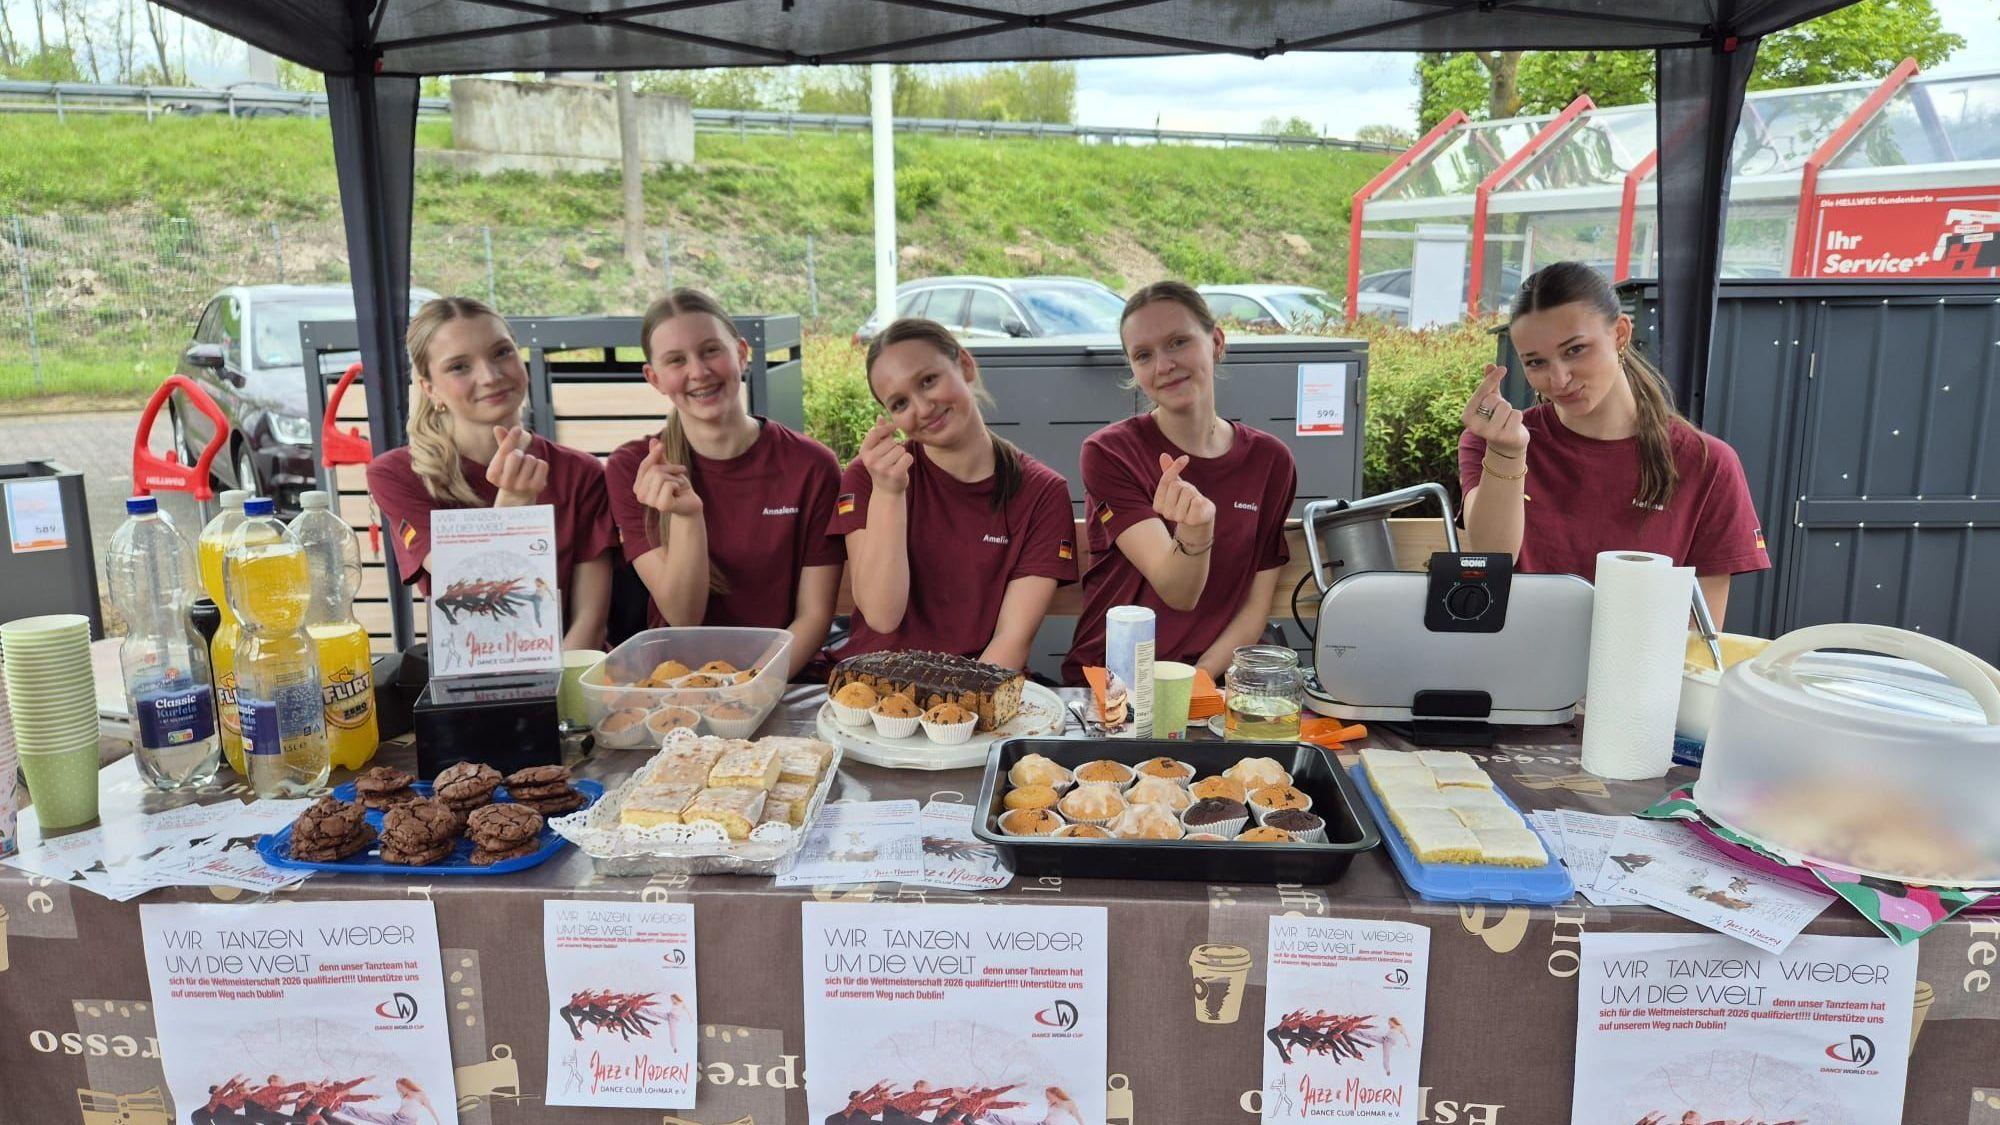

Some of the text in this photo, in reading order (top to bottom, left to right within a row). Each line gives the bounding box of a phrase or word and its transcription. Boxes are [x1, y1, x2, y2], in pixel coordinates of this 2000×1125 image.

[1820, 196, 1934, 208] Die HELLWEG Kundenkarte
[1827, 230, 1862, 250] Ihr
[1822, 252, 1930, 274] Service+
[1234, 501, 1258, 512] Leonie
[982, 534, 1008, 544] Amelie
[322, 672, 371, 704] FLIRT
[155, 694, 196, 708] Classic
[164, 954, 418, 974] UM DIE WELT denn unser Tanzteam hat
[825, 954, 1084, 976] UM DIE WELT denn unser Tanzteam hat
[169, 974, 419, 988] sich für die Weltmeisterschaft 2026 qualifiziert!!!! Unterstütze uns
[825, 976, 1083, 990] sich für die Weltmeisterschaft 2026 qualifiziert!!!! Unterstütze uns
[171, 990, 284, 1000] auf unserem Weg nach Dublin!
[826, 990, 944, 1000] auf unserem Weg nach Dublin!
[1601, 984, 1886, 1010] UM DIE WELT denn unser Tanzteam hat
[1600, 1008, 1884, 1024] sich für die Weltmeisterschaft 2026 qualifiziert!!!! Unterstütze uns
[1598, 1020, 1727, 1033] auf unserem Weg nach Dublin!
[635, 1054, 689, 1087] MODERN
[706, 1055, 807, 1090] pre
[626, 1086, 643, 1094] CLUB
[1346, 1078, 1403, 1111] MODERN
[1356, 1110, 1386, 1118] LOHMAR
